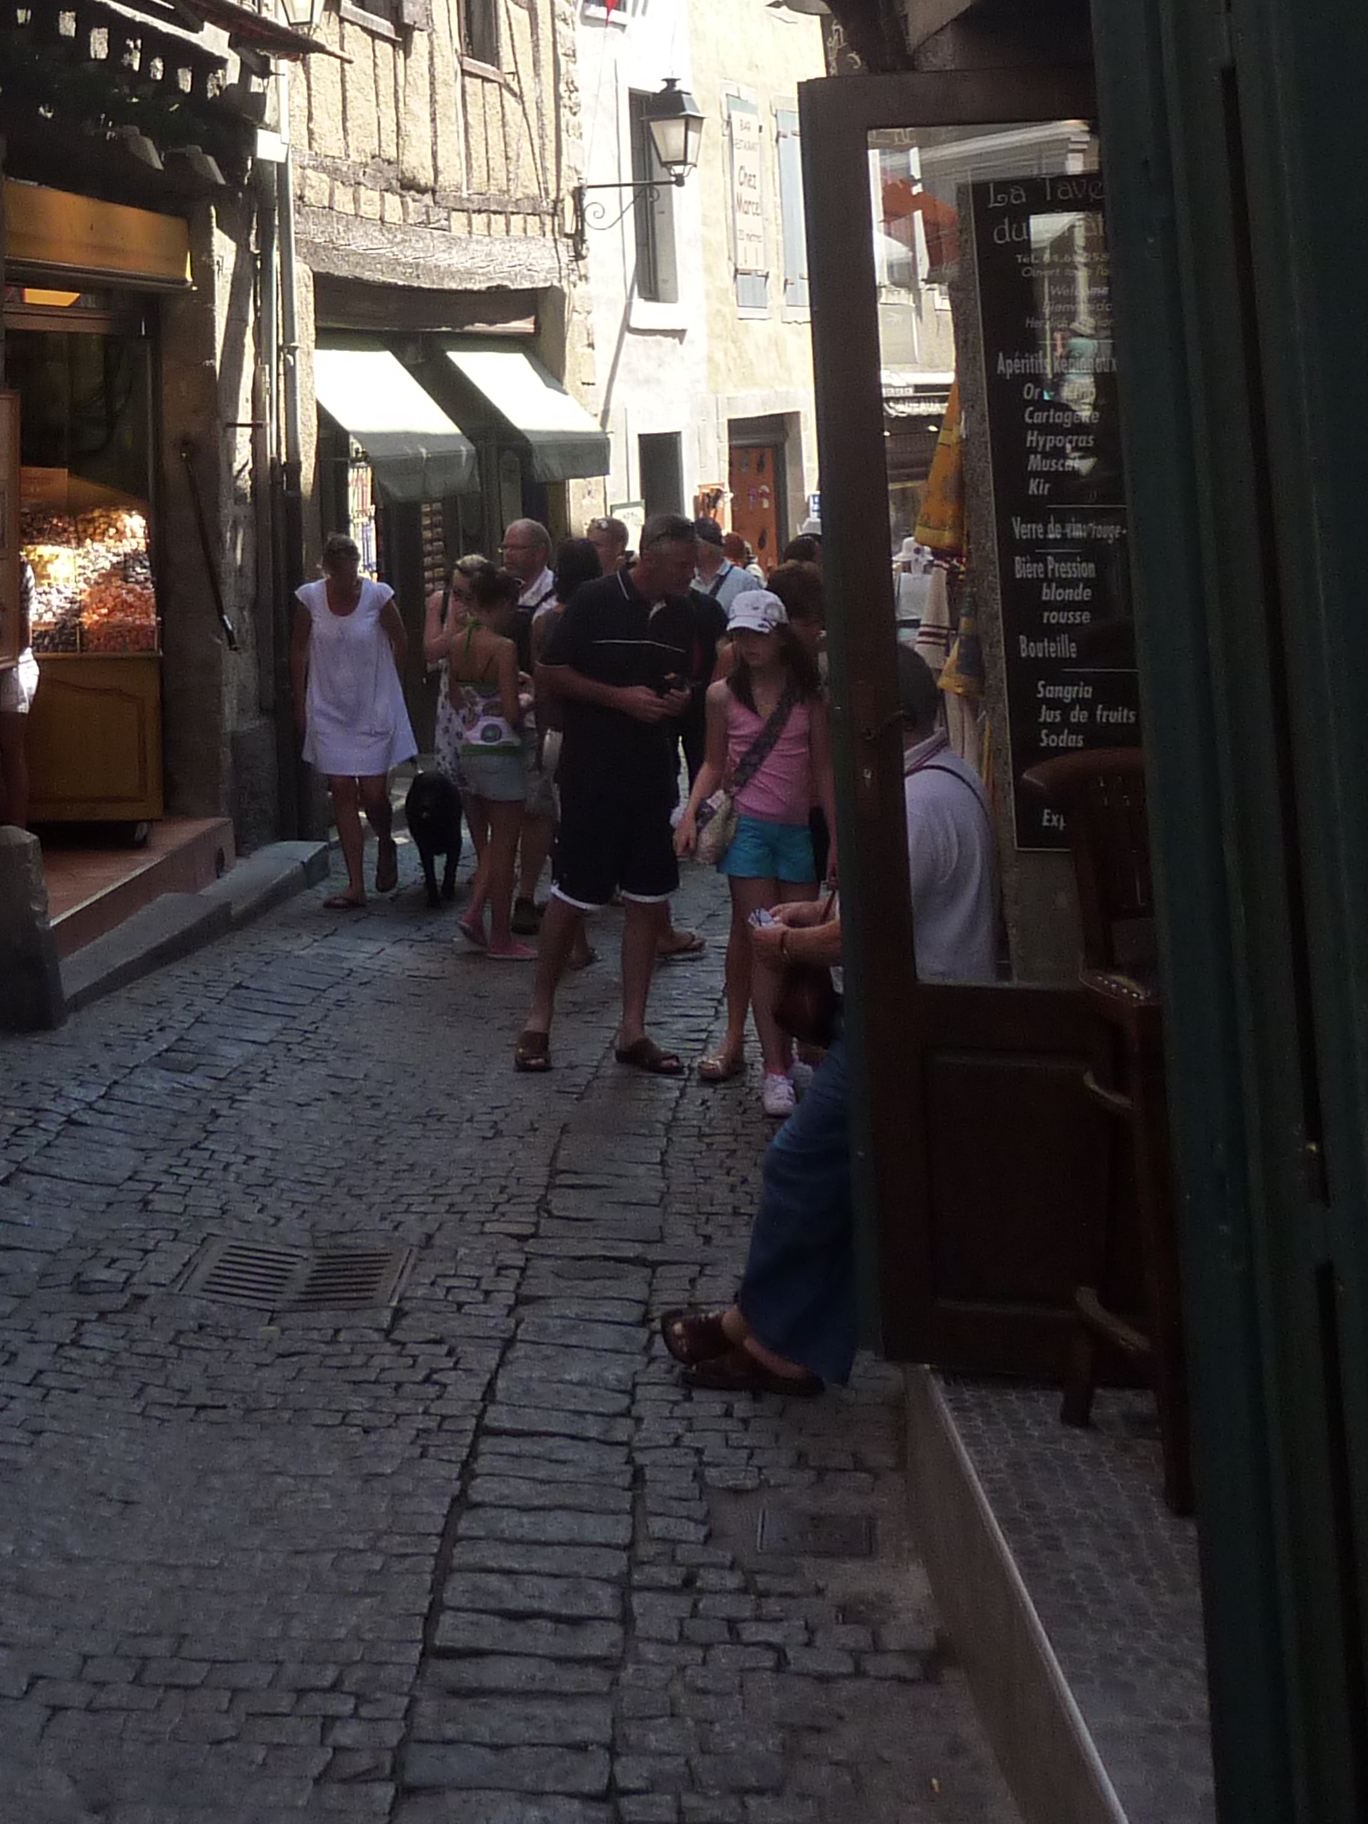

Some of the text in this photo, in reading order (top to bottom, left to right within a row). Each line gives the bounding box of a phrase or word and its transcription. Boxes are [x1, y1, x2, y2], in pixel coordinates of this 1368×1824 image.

[738, 165, 757, 190] Chez
[988, 182, 1027, 208] La
[993, 216, 1028, 244] du
[1026, 430, 1094, 451] Hypocras
[1029, 478, 1051, 495] Kir
[1012, 516, 1045, 539] Verre
[1047, 514, 1062, 539] de
[1014, 555, 1096, 578] Bière Pression
[1042, 582, 1092, 601] blonde
[1043, 611, 1092, 624] rousse
[1019, 634, 1078, 658] Bouteille
[1036, 680, 1093, 703] Sangria
[1038, 703, 1137, 723] Jus de fruits
[1040, 728, 1085, 747] Sodas
